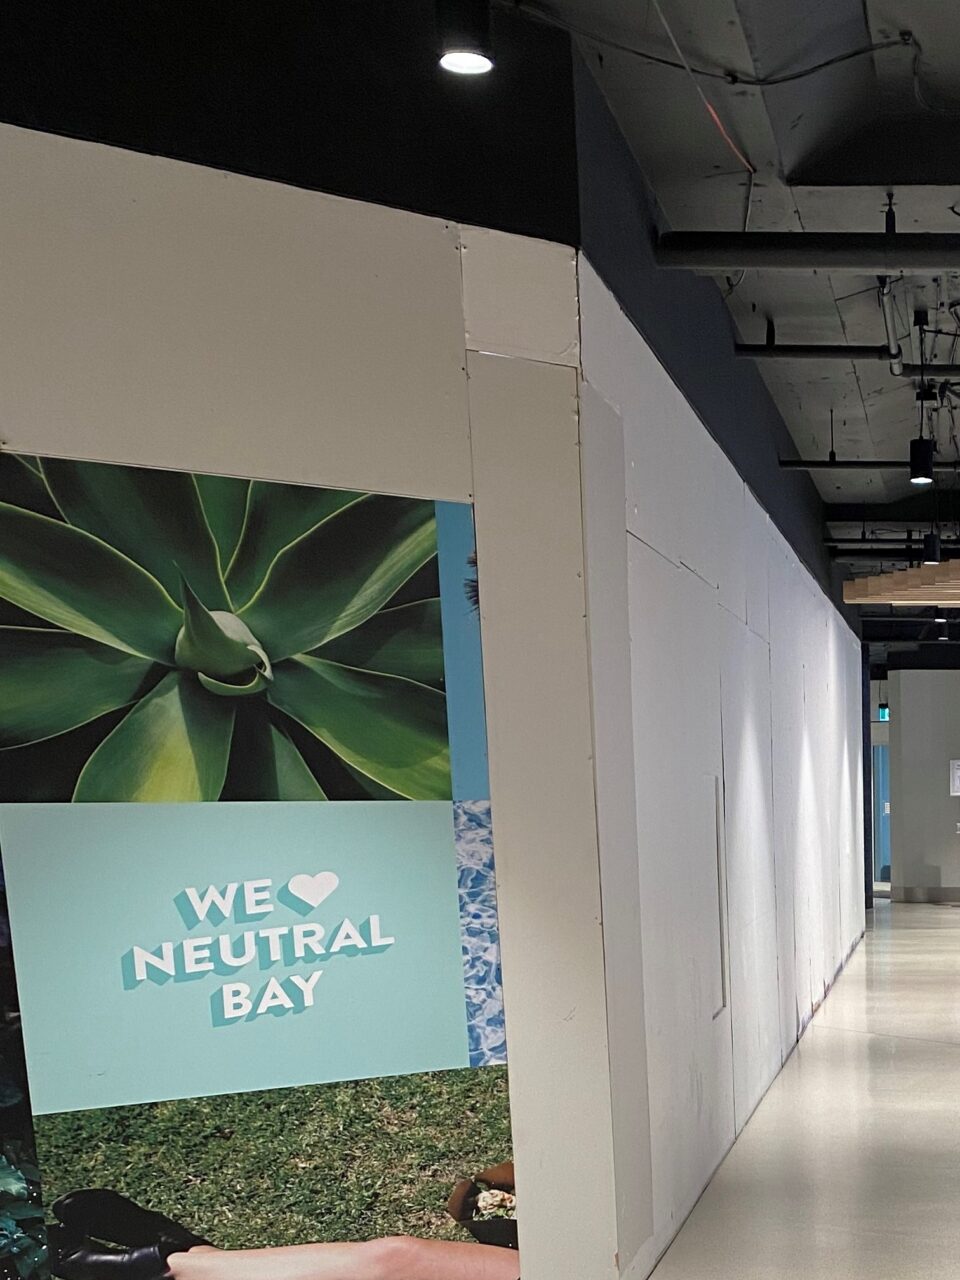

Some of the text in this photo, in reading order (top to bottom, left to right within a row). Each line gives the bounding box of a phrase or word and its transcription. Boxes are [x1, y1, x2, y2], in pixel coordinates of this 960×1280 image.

[182, 878, 275, 923] WE
[130, 914, 396, 982] NEUTRAL
[219, 969, 324, 1020] BAY
